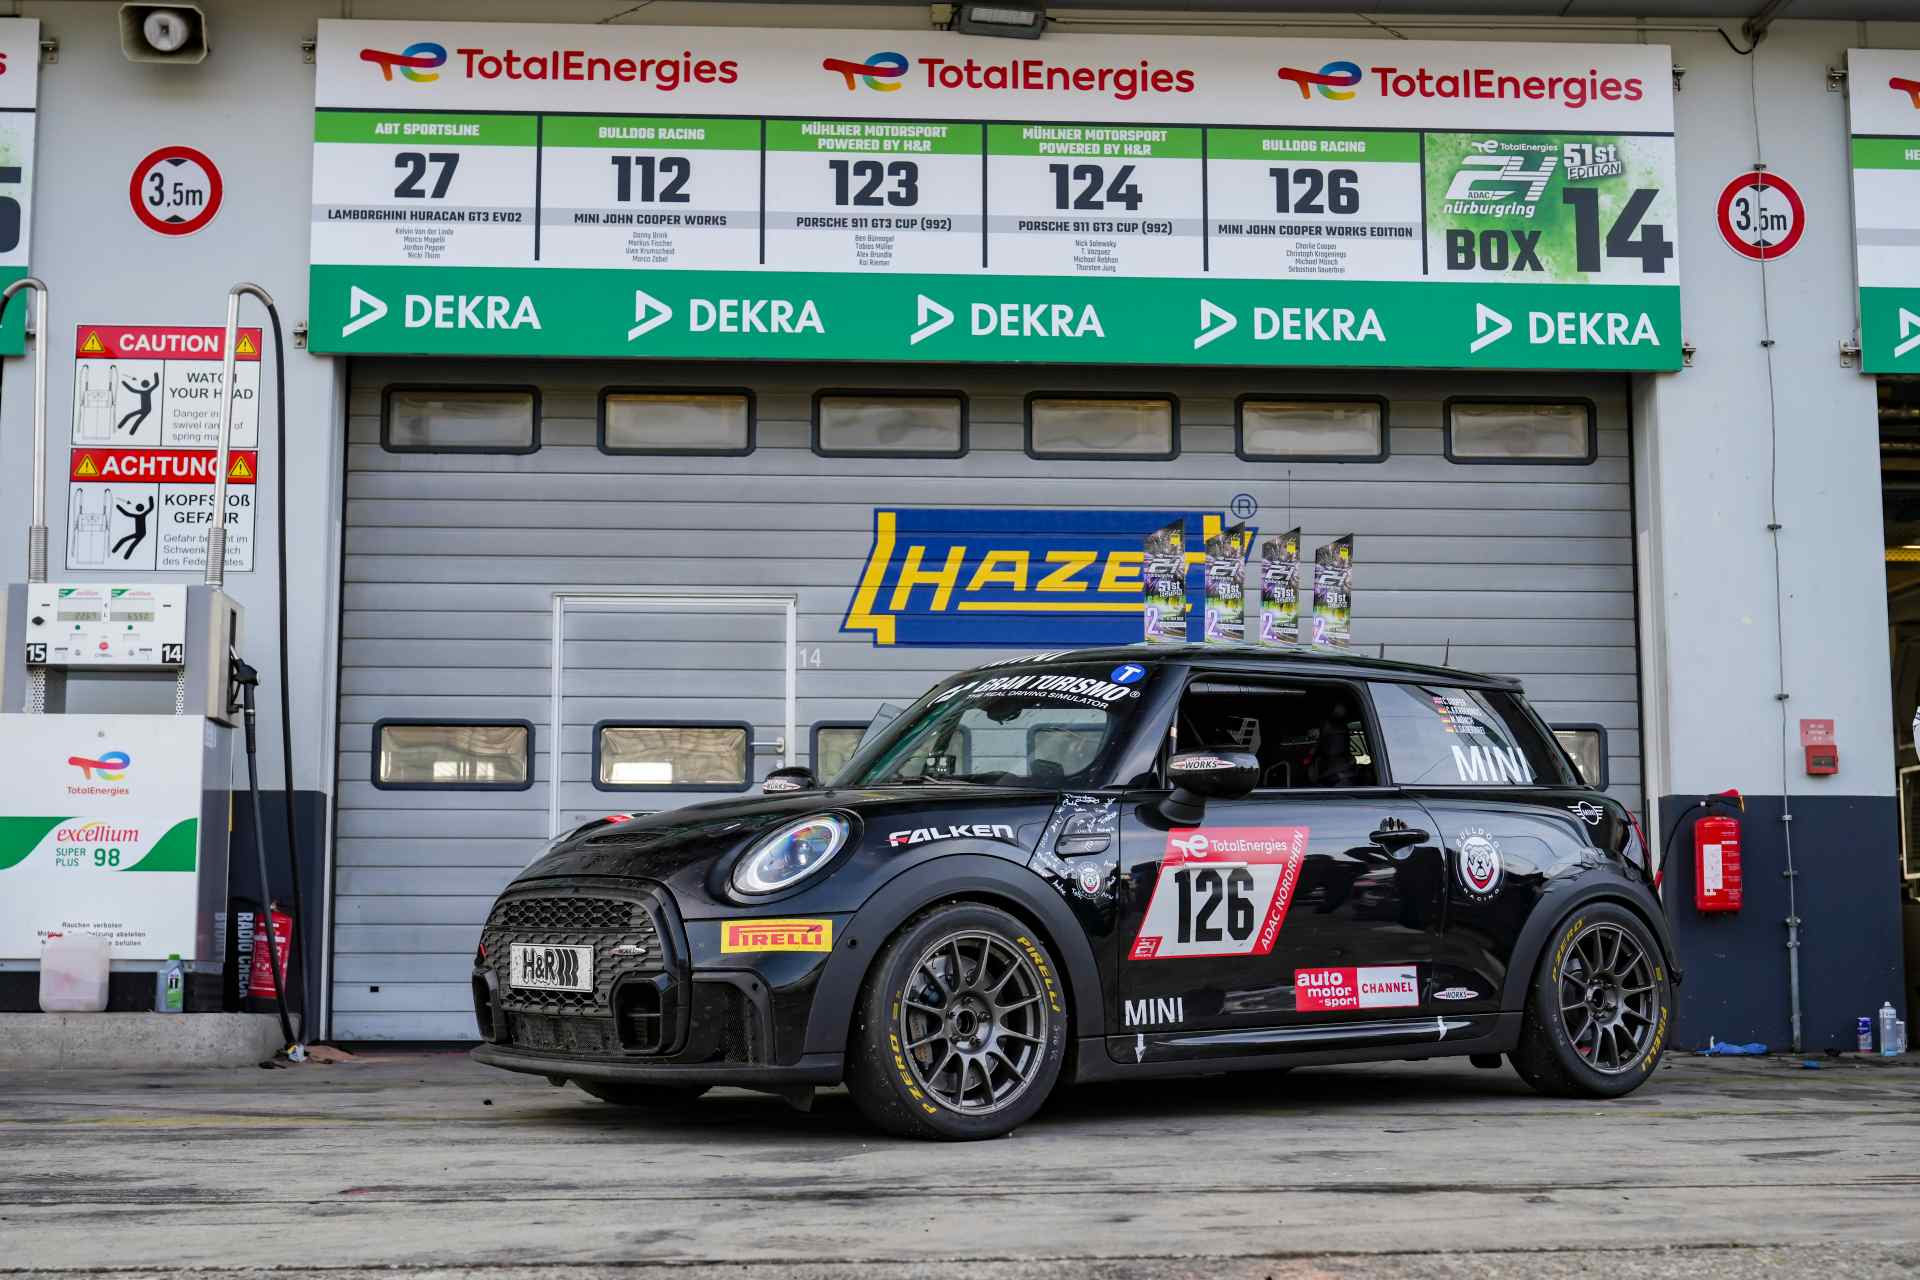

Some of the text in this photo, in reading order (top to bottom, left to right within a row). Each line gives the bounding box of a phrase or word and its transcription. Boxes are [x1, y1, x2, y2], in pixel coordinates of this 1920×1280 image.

[457, 48, 738, 91] TotalEnergies
[918, 58, 1195, 101] TotalEnergies
[1371, 66, 1643, 109] TotalEnergies
[375, 123, 480, 136] ABT SPORTSLINE
[599, 127, 705, 141] BULLDOG RACING
[802, 123, 947, 138] MÜHLNER MOTORSPORT
[1023, 126, 1167, 142] MÜHLNER MOTORSPORT
[818, 138, 932, 152] POWERED BY H&R
[1039, 142, 1152, 156] POWERED BY H&R
[1263, 139, 1366, 153] BULLDOG RACING
[1501, 143, 1558, 153] TotalEnergies
[1564, 143, 1616, 167] 51st
[394, 152, 460, 199] 27
[1568, 160, 1623, 179] EDITION
[612, 156, 691, 203] 112
[829, 160, 919, 207] 123
[1049, 164, 1143, 211] 124
[150, 172, 203, 207] 3,5m
[1270, 168, 1360, 214] 126
[1468, 192, 1490, 200] ADAC
[328, 209, 406, 222] LAMBORGHINI
[410, 210, 461, 223] HURACAN
[465, 210, 489, 223] GT3
[1444, 202, 1536, 218] nürburgring
[574, 213, 727, 226] MINI JOHN COOPER WORKS
[796, 216, 952, 232] PORSCHE 911 GT3 CUP (992)
[1018, 220, 1173, 236] PORSCHE 911 GT3 CUP (992)
[1218, 224, 1413, 238] MINI JOHN COOPER WORKS EDITION
[1562, 188, 1674, 273] 14
[1446, 229, 1544, 272] BOX
[404, 295, 542, 330] DEKRA
[690, 299, 826, 334] DEKRA
[971, 304, 1105, 338] DEKRA
[1253, 308, 1386, 343] DEKRA
[1529, 312, 1661, 347] DEKRA
[119, 334, 219, 353] CAUTION
[169, 388, 254, 399] YOUR HAD
[173, 408, 208, 420] Danger
[165, 494, 250, 507] KOPFSOß
[164, 534, 196, 543] Gefahr
[1159, 581, 1181, 592] 51st
[1219, 583, 1240, 594] 51st
[1274, 588, 1294, 599] 51st
[27, 644, 46, 662] 15
[163, 645, 182, 662] 14
[800, 648, 821, 669] 14
[974, 676, 1132, 701] GRAN TURISMO
[1048, 692, 1109, 710] SIMULATOR
[1185, 760, 1217, 769] WORKS
[1451, 744, 1534, 782] MINI
[67, 786, 130, 797] TotalEnergies
[57, 825, 141, 843] excellium
[887, 824, 1016, 847] FALKEN
[1456, 828, 1501, 849] BULLDOG
[56, 848, 86, 857] SUPER
[1211, 839, 1287, 854] TotalEnergies
[56, 858, 80, 867] PLUS
[94, 848, 121, 867] 98
[1260, 831, 1305, 951] ADAC NORDRHEIN
[1175, 868, 1255, 944] 126
[238, 912, 254, 952] RADIO
[729, 924, 823, 946] PIRELLI
[523, 948, 557, 983] H&R
[1016, 936, 1061, 1013] PIRELLI
[1298, 972, 1343, 987] auto
[1362, 982, 1413, 994] CHANNEL
[1308, 986, 1352, 998] motor
[1445, 992, 1467, 1000] WORKS
[1324, 996, 1357, 1008] sport
[1125, 997, 1184, 1026] MINI
